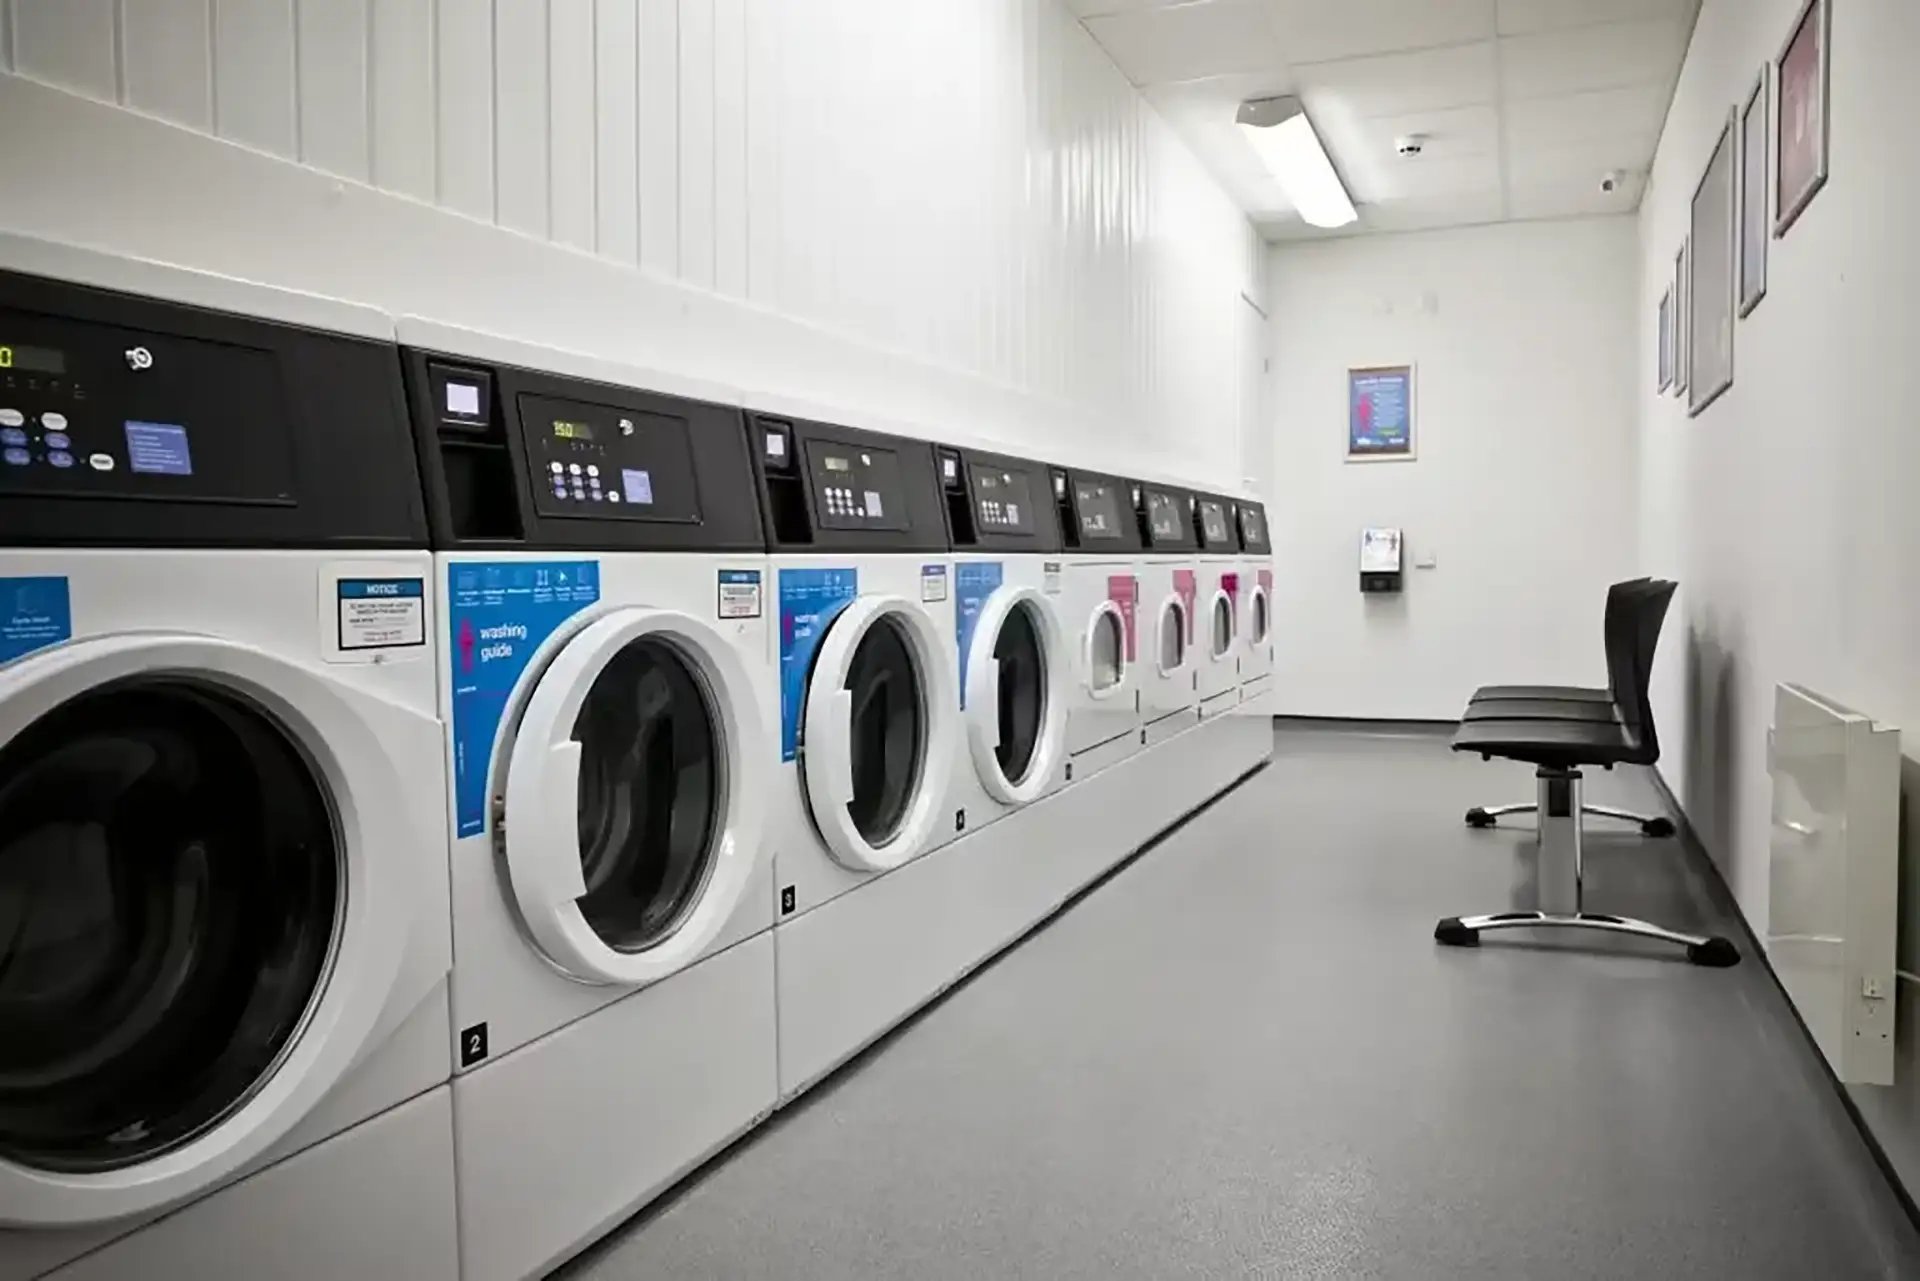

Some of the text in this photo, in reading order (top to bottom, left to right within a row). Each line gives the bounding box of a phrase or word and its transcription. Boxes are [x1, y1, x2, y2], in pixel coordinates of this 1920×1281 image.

[366, 583, 399, 595] NOTICE
[480, 622, 527, 640] washing
[481, 643, 513, 663] guide
[784, 893, 792, 907] 3
[470, 1034, 481, 1054] 2
